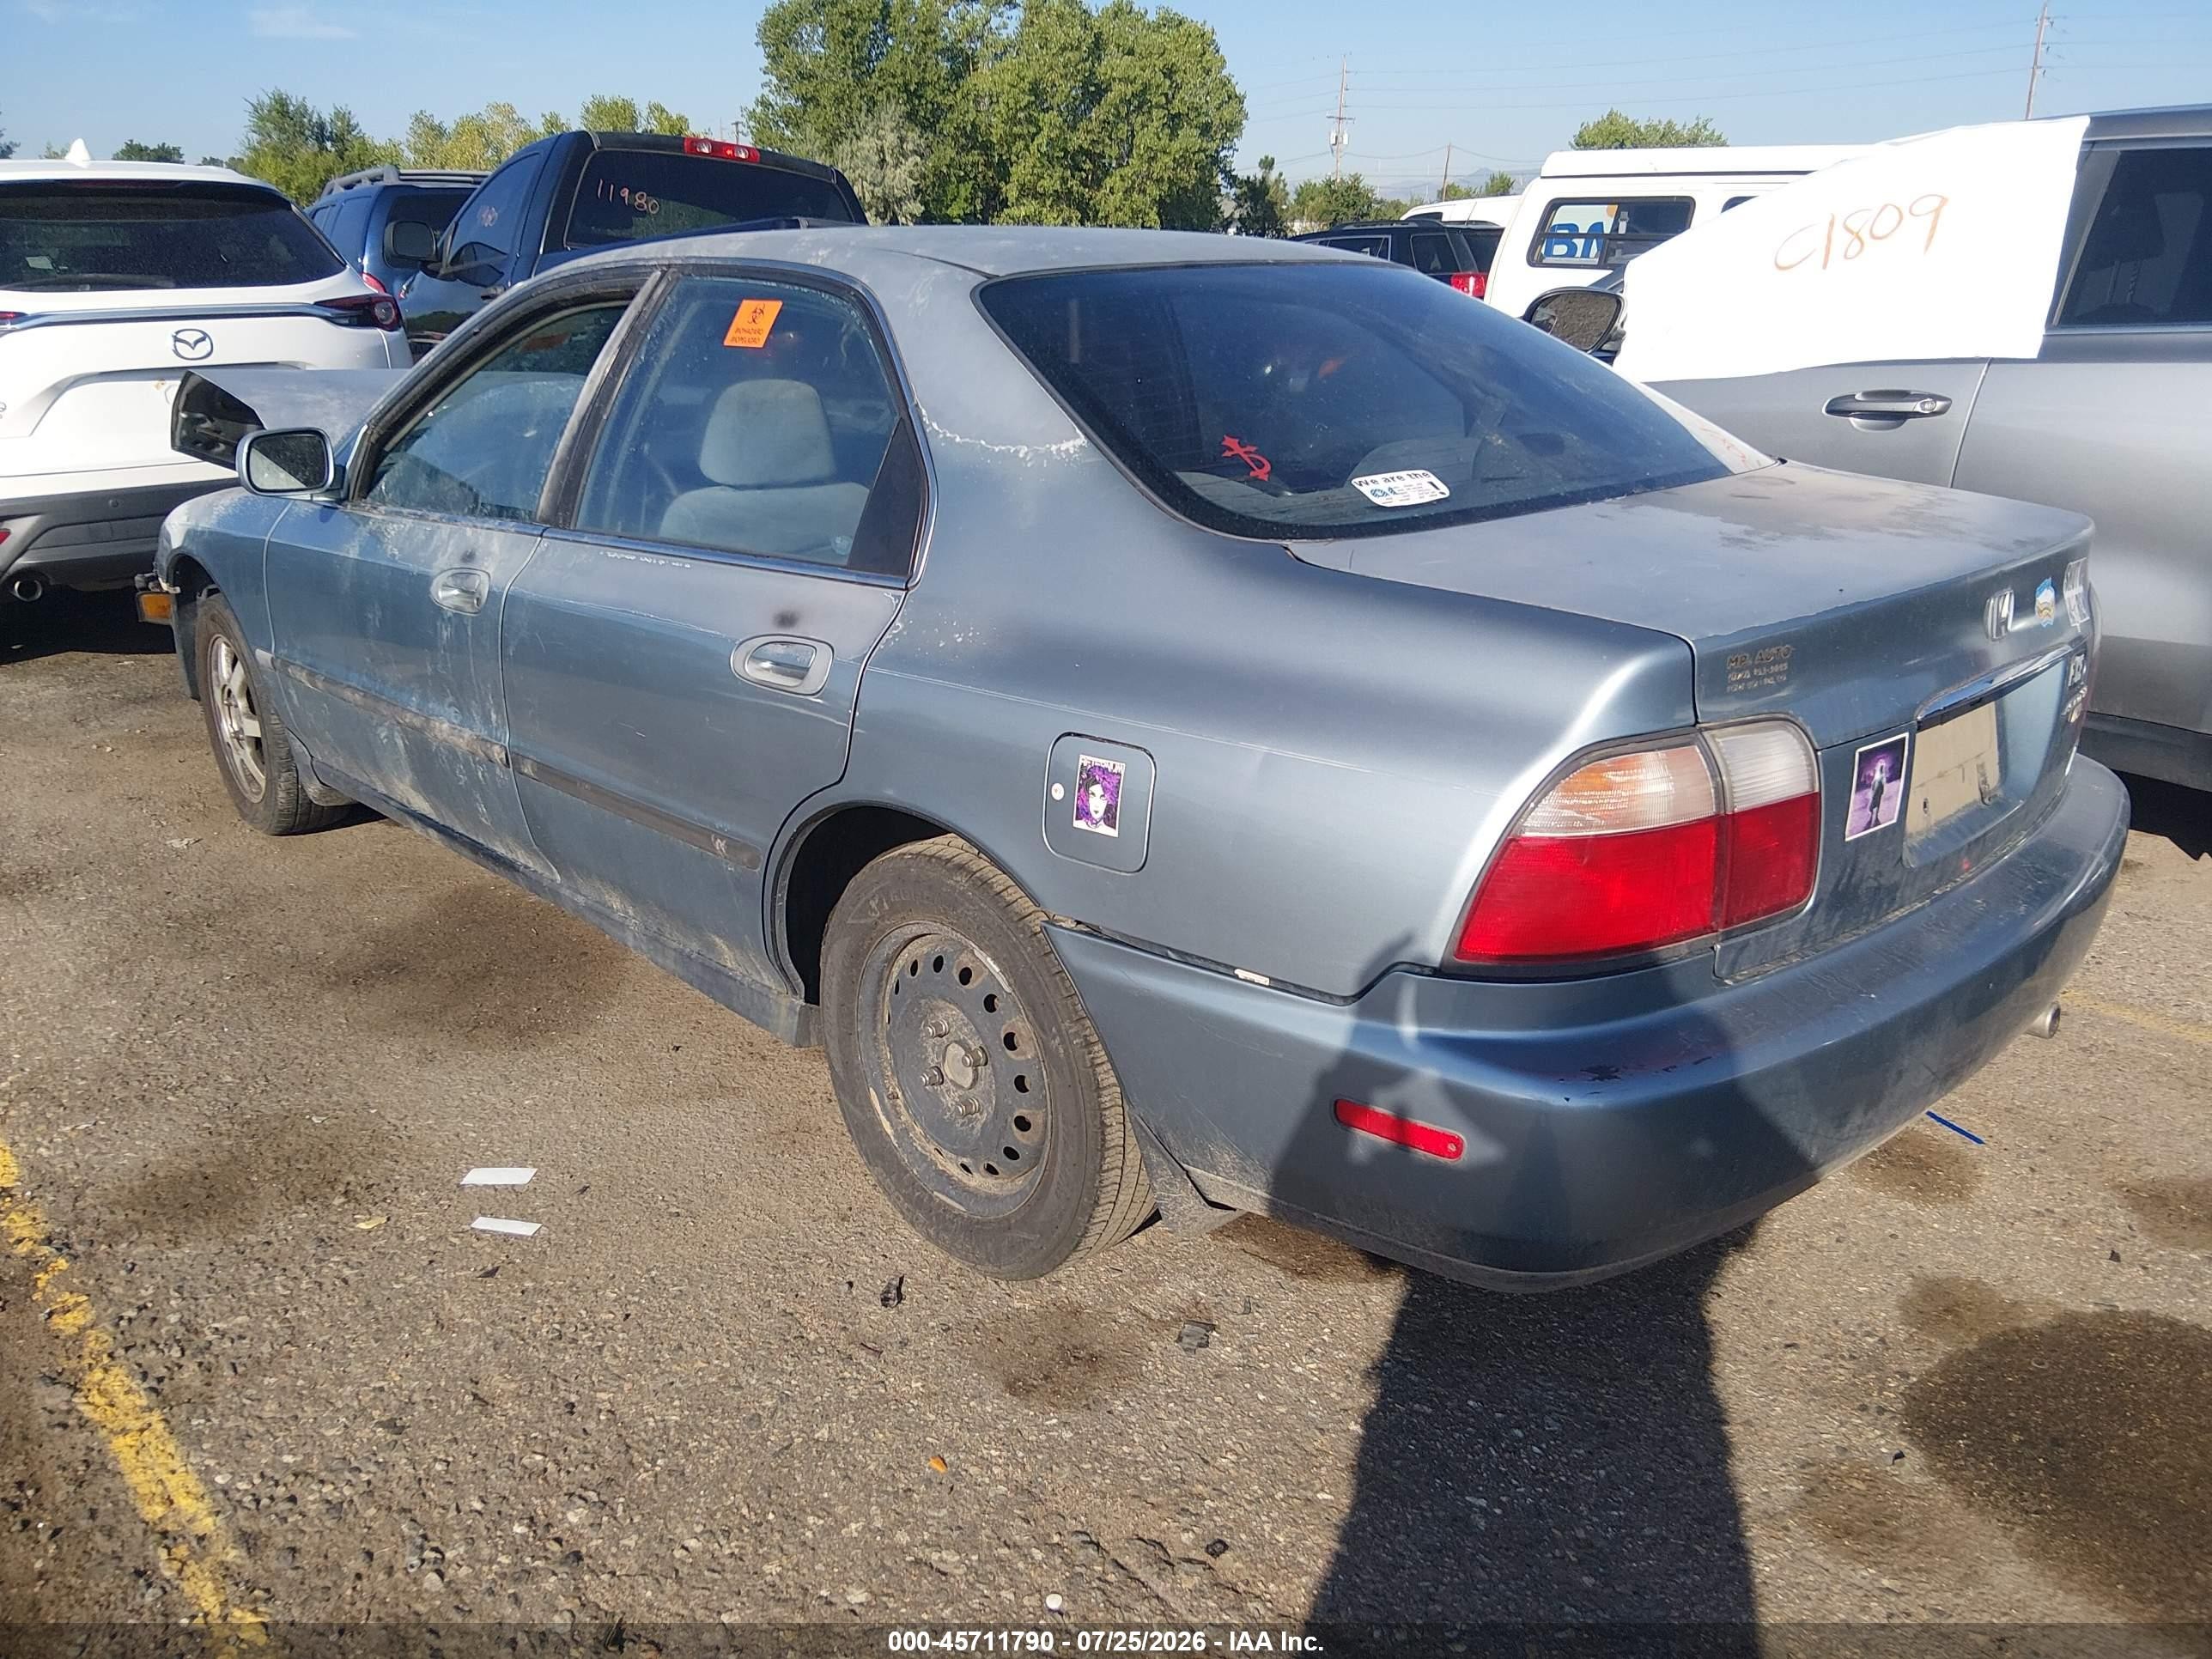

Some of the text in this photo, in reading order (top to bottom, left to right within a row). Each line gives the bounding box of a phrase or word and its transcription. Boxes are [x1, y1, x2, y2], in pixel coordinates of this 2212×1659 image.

[598, 178, 659, 214] 11980
[1774, 194, 1948, 270] C1809
[1353, 471, 1431, 487] We are the
